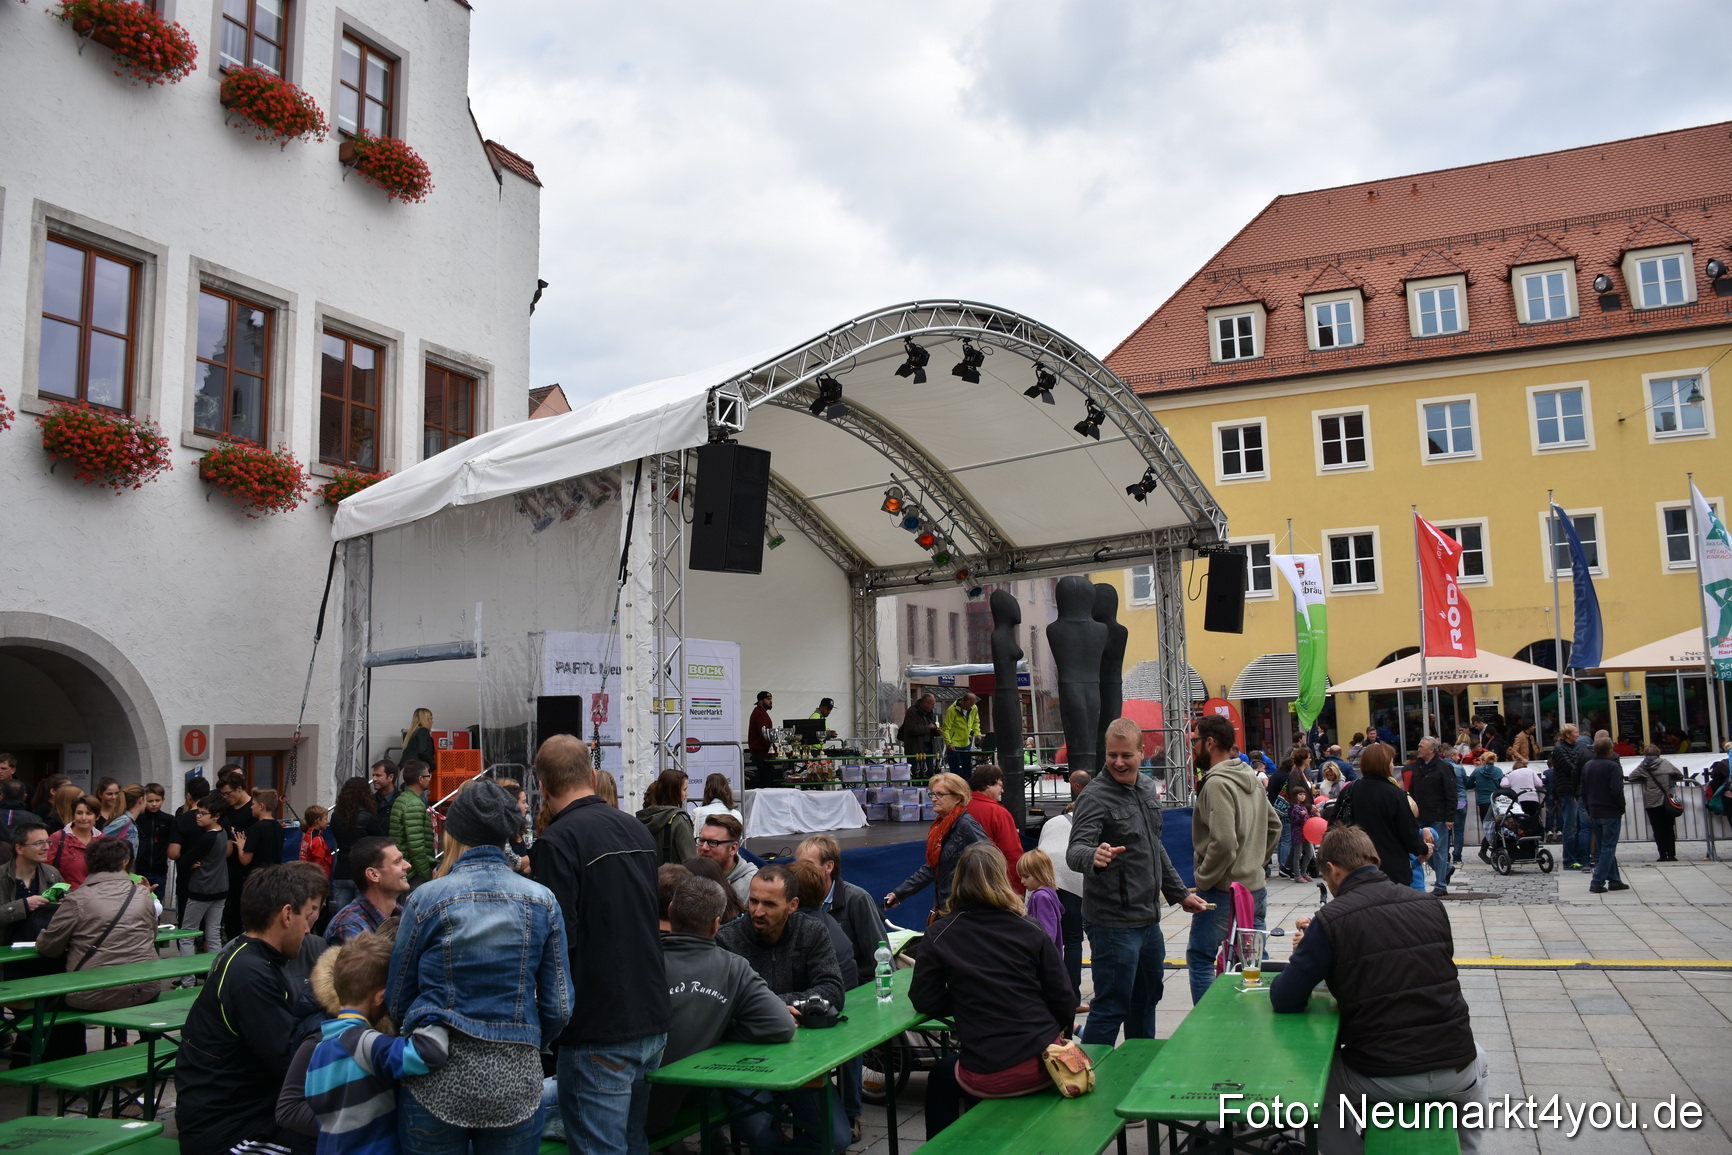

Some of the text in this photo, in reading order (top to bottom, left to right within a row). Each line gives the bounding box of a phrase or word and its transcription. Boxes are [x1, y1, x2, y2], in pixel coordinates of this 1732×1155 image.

[688, 664, 724, 676] BOCK
[669, 981, 728, 1003] eed Runners
